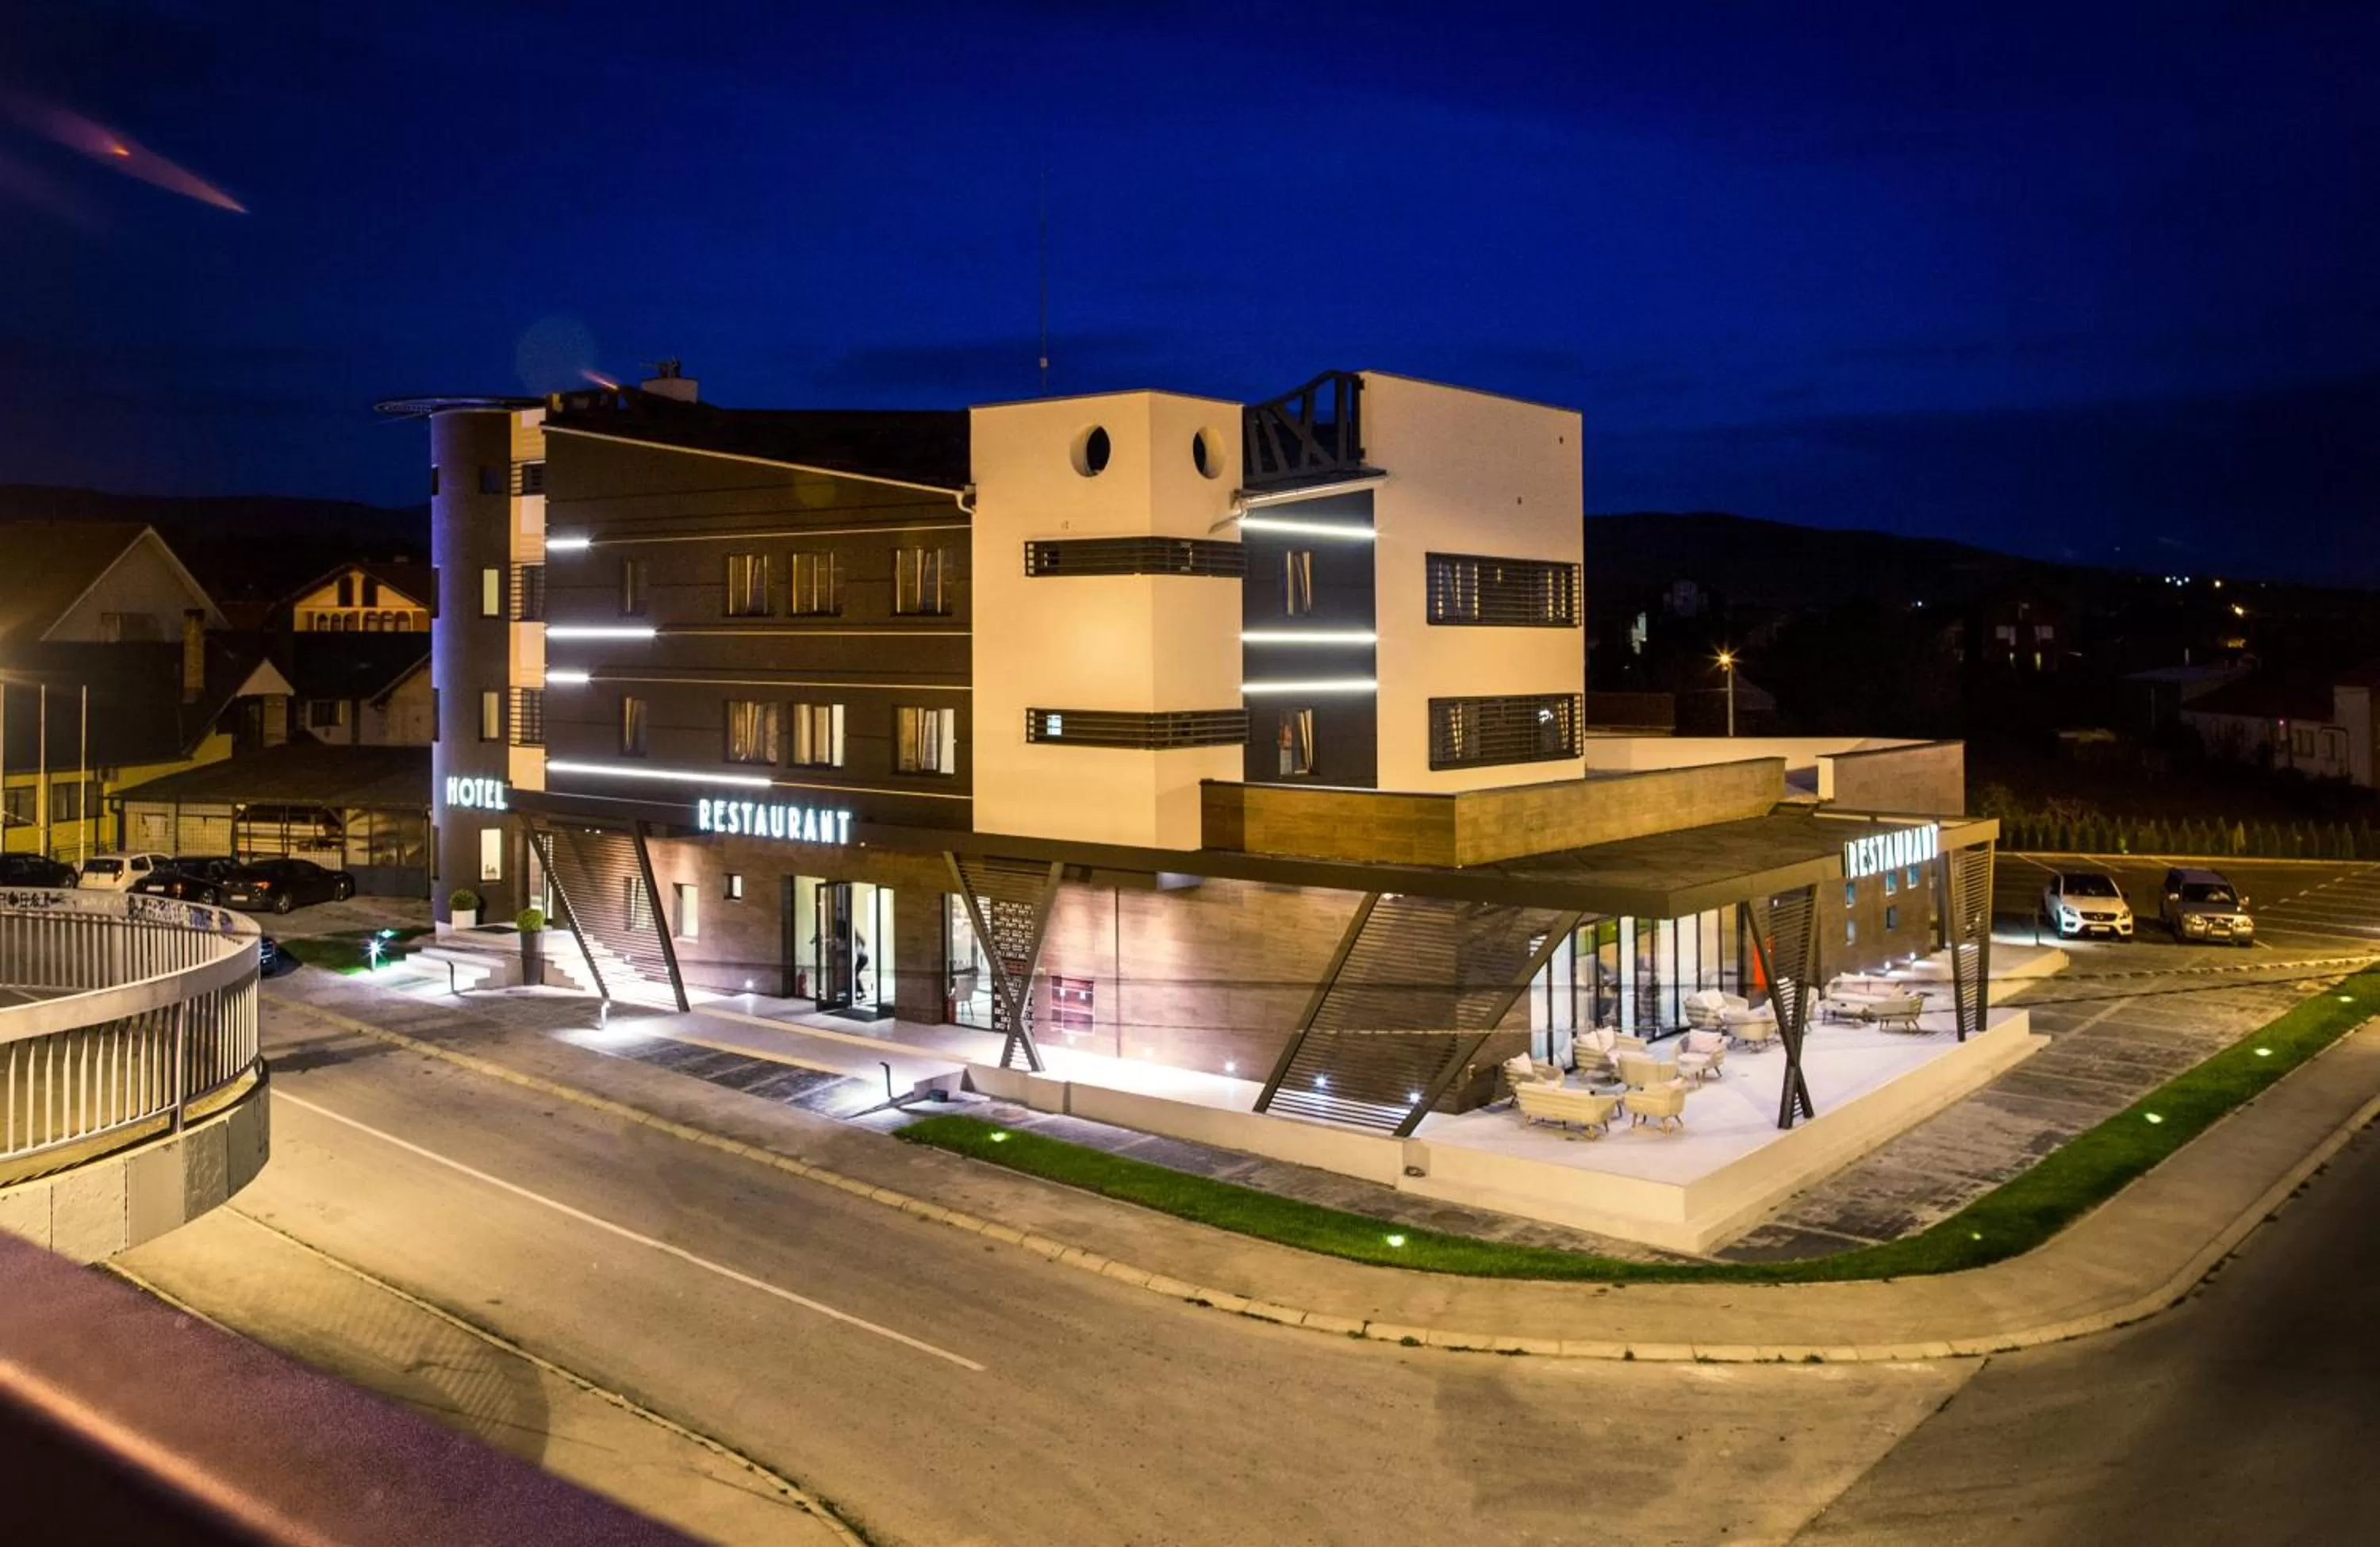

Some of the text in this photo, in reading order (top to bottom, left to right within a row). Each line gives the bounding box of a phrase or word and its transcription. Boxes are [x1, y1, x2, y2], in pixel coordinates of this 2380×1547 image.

[446, 777, 508, 810] HOTEL
[698, 797, 851, 845] RESTAURANT
[1846, 823, 1938, 878] RESTAURANT
